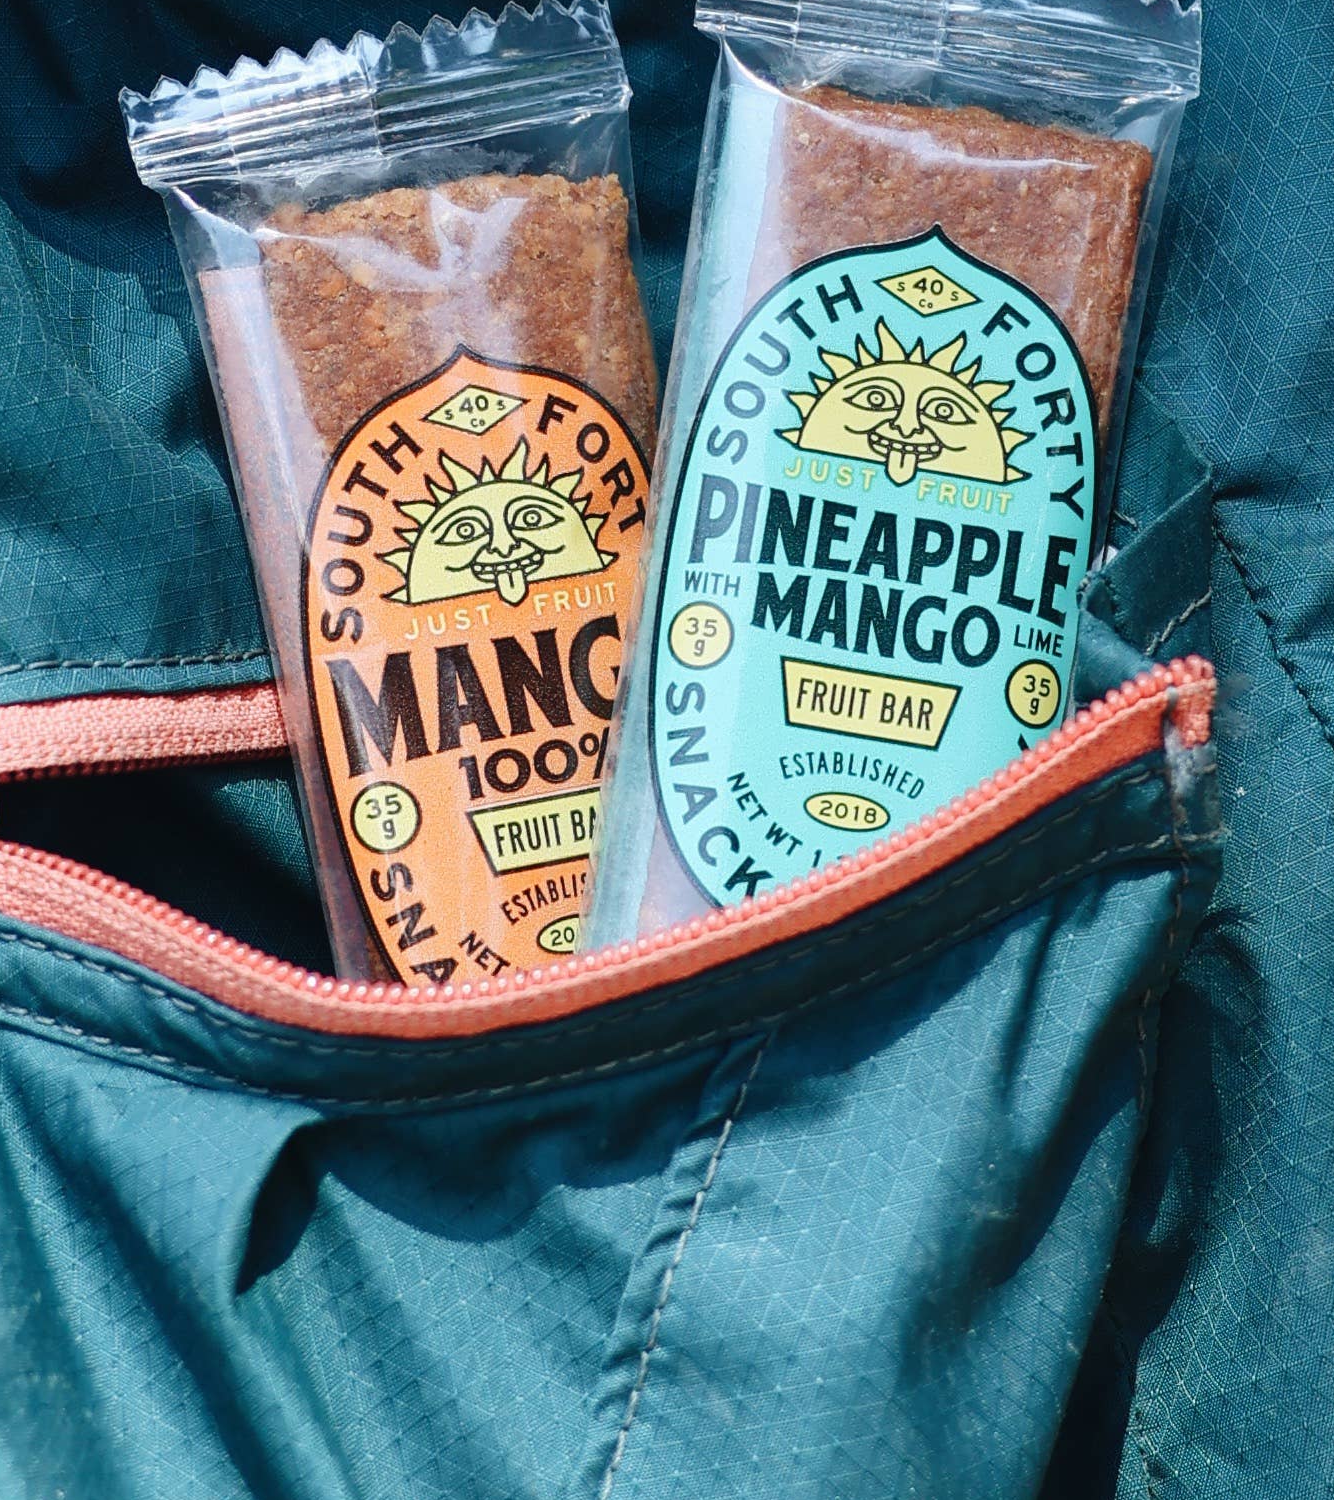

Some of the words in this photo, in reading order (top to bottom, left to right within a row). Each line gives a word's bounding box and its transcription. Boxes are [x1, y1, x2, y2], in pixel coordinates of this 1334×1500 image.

[896, 281, 906, 292] S
[912, 277, 944, 296] 40
[950, 290, 960, 301] S
[458, 394, 490, 414] 40
[707, 274, 864, 465] SOUTH
[981, 302, 1086, 520] FORTY
[783, 456, 877, 492] JUST
[916, 477, 1014, 515] FRUIT
[320, 420, 424, 645] SOUTH
[536, 392, 646, 534] FORT
[687, 473, 1078, 628] PINEAPPLE
[405, 603, 493, 640] JUST
[533, 581, 618, 617] FRUIT
[684, 569, 742, 598] WITH
[749, 571, 1002, 669] MANGO
[1013, 623, 1064, 658] LIME
[684, 616, 719, 638] 35
[693, 638, 706, 658] g
[326, 614, 622, 779] MANG
[795, 677, 872, 722] FRUIT
[880, 693, 935, 731] BAR
[1022, 674, 1052, 698] 35
[1029, 697, 1040, 716] g
[667, 681, 773, 899] SNACK
[779, 751, 926, 800] ESTABLISHED
[365, 793, 403, 820] 35
[382, 820, 397, 840] g
[493, 812, 560, 857] FRUIT
[570, 805, 598, 843] BA
[726, 771, 769, 822] NET
[764, 821, 804, 857] WT
[818, 799, 878, 825] 2018
[370, 862, 460, 986] SNA
[550, 926, 576, 947] 20
[458, 929, 512, 977] NET
